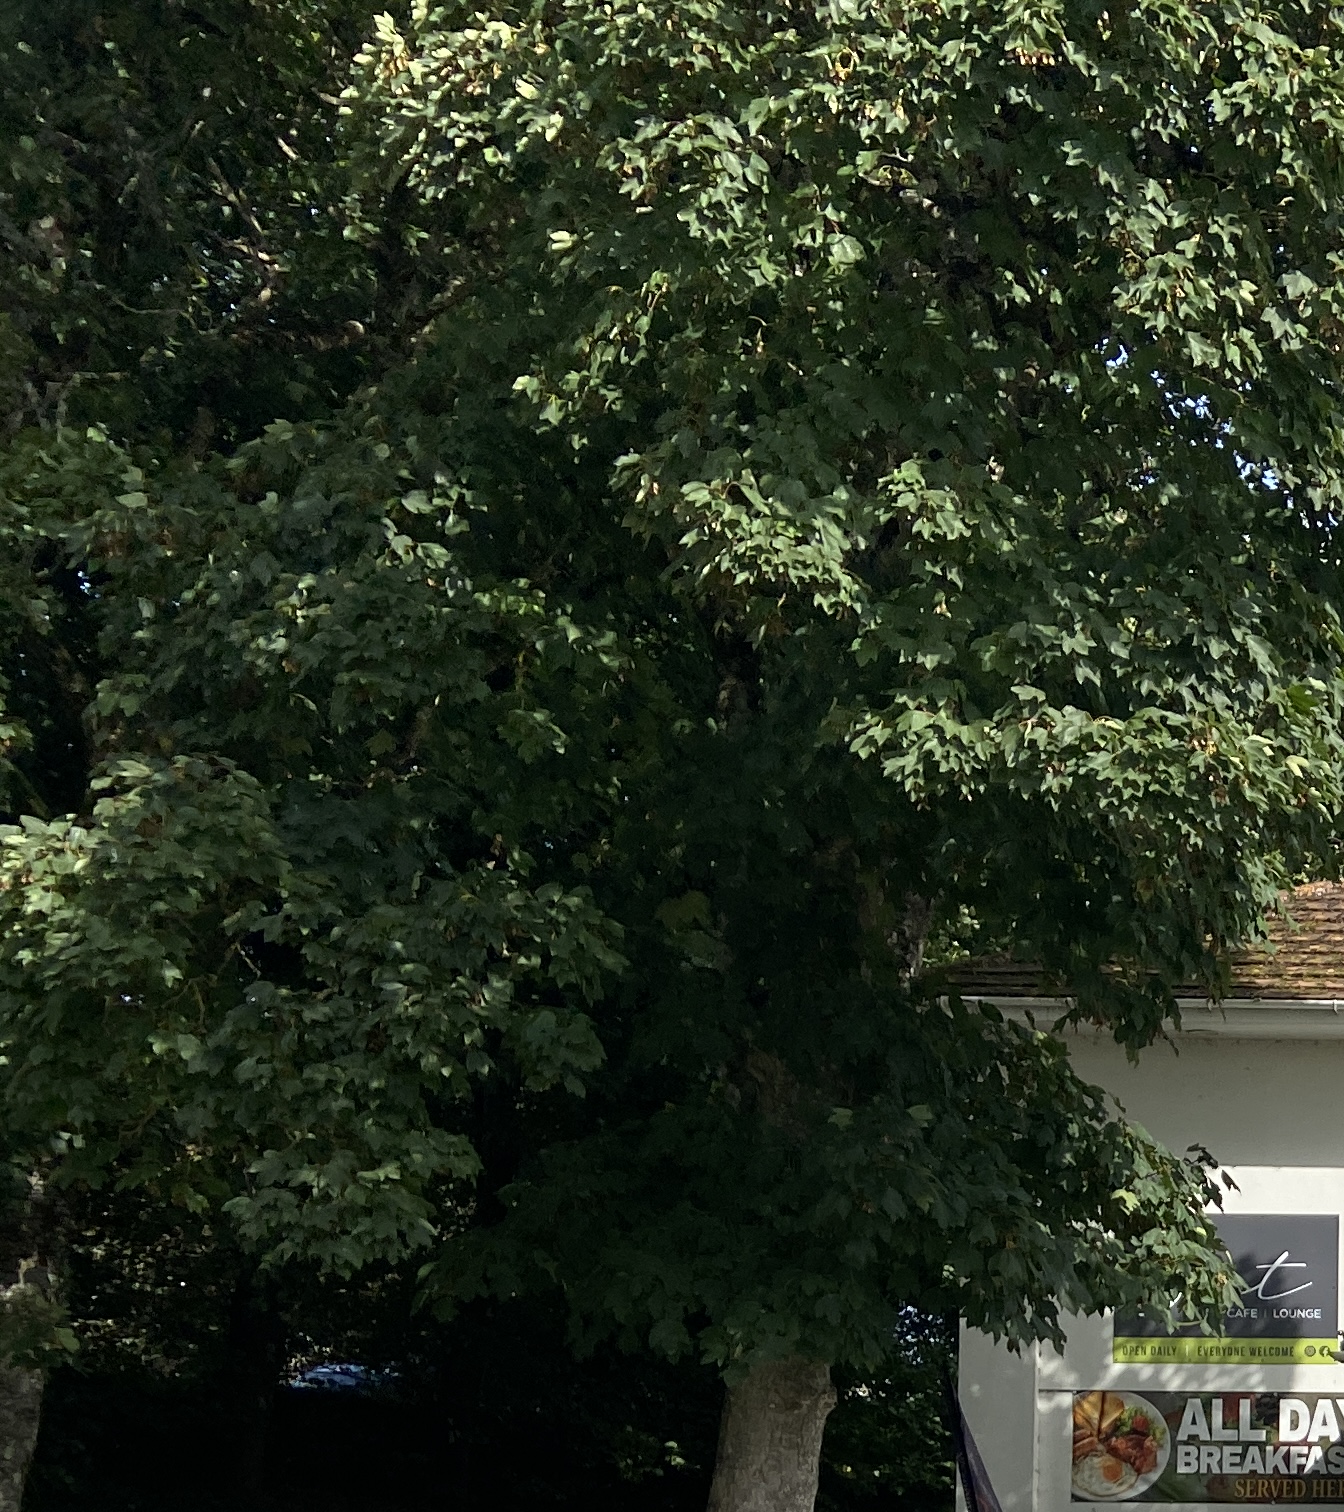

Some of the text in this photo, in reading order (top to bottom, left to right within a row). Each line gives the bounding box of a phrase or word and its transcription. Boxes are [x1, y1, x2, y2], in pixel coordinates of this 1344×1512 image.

[1226, 1308, 1322, 1319] CAFE LOUNGE
[1122, 1345, 1177, 1356] OPEN DAILY
[1197, 1345, 1294, 1357] EVERYONE WELCOME
[1176, 1398, 1267, 1442] ALL
[1234, 1479, 1306, 1498] SERVED
